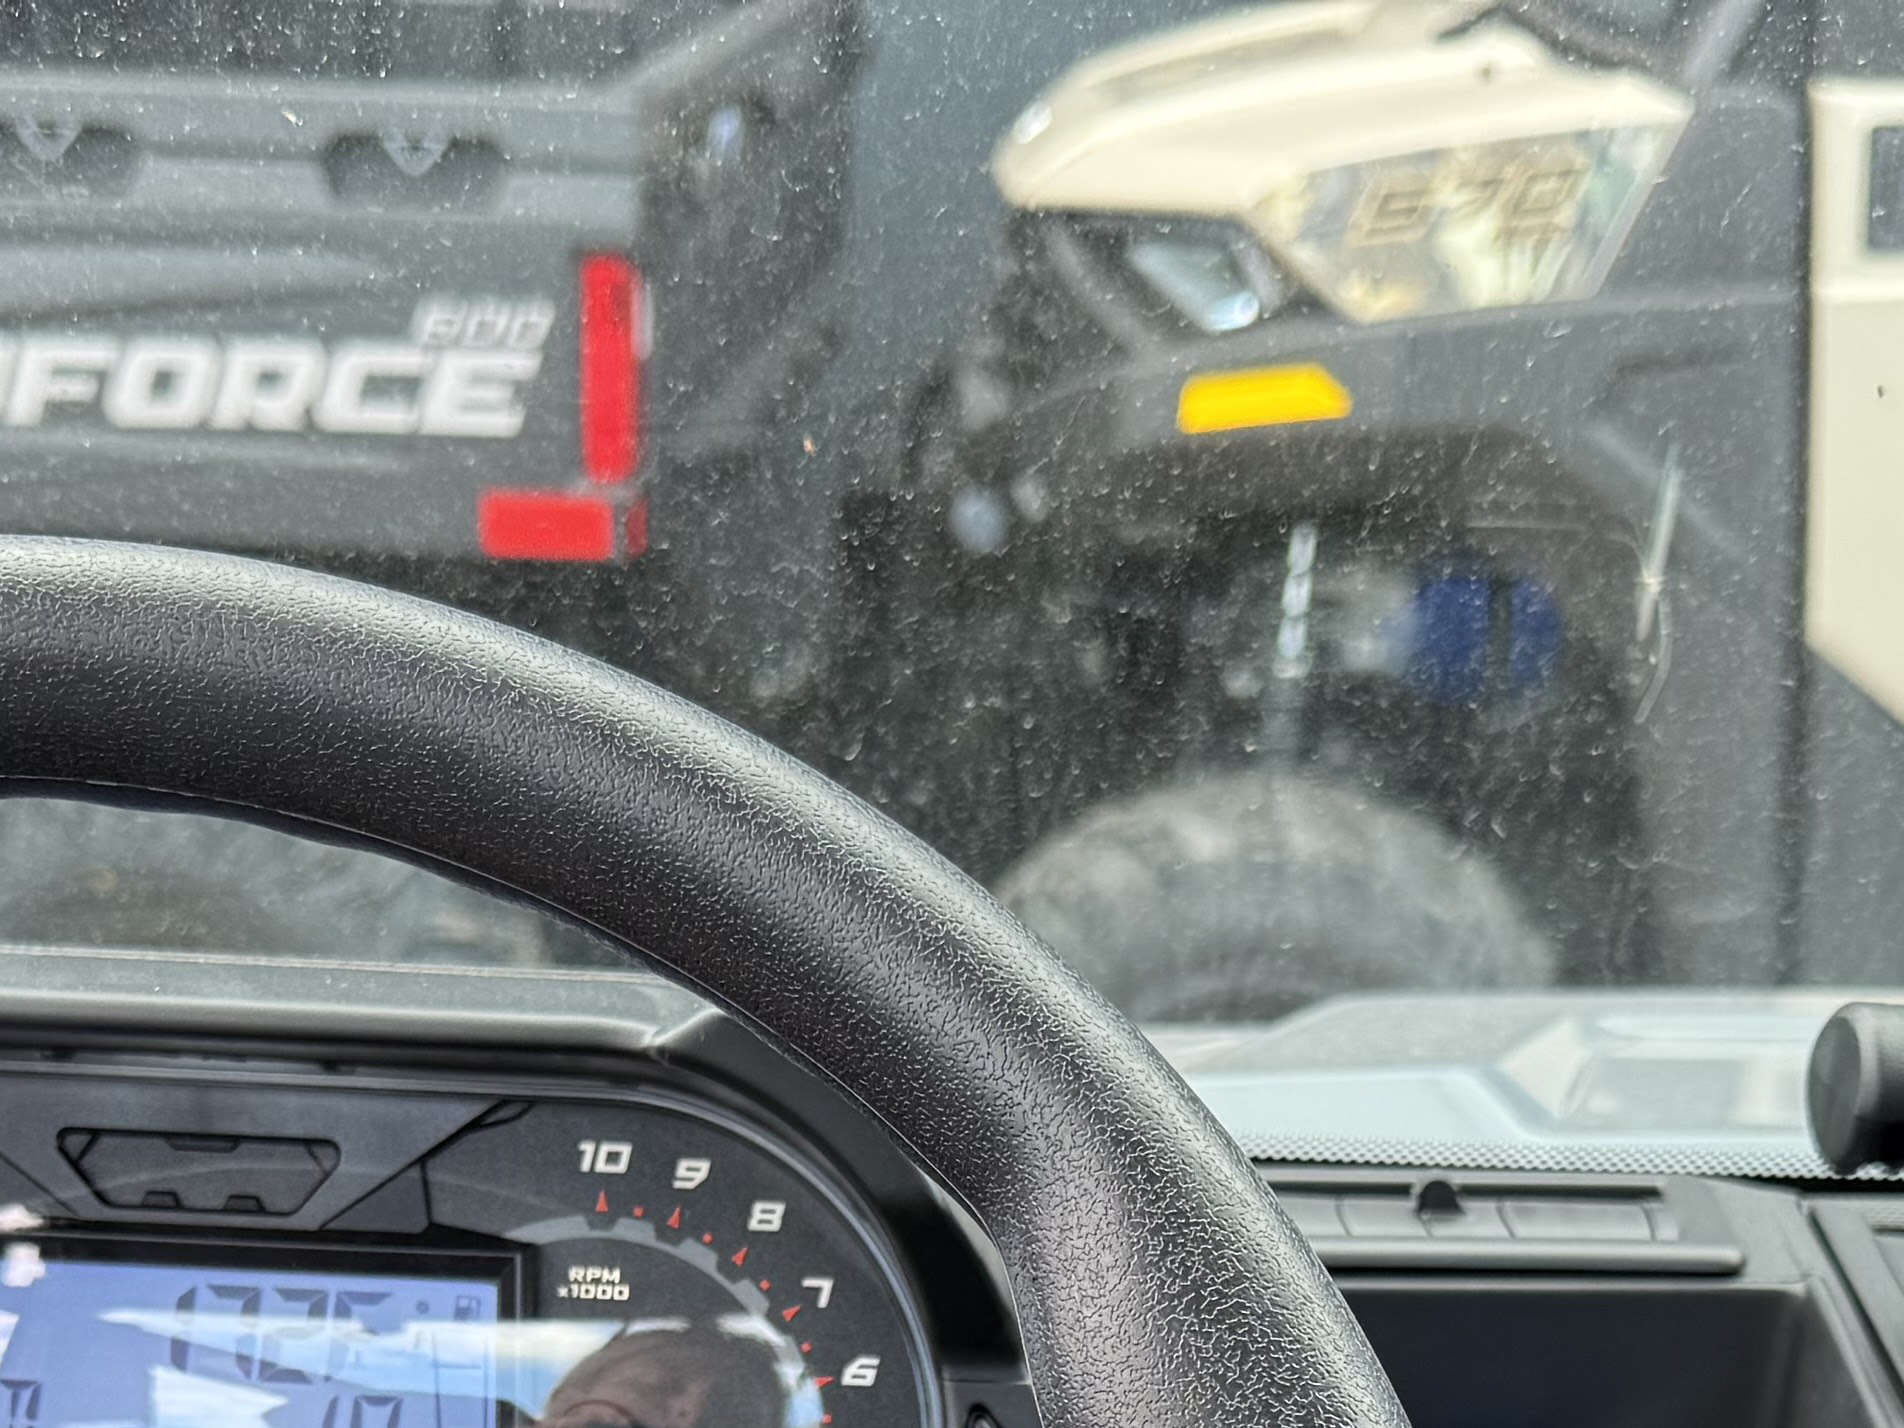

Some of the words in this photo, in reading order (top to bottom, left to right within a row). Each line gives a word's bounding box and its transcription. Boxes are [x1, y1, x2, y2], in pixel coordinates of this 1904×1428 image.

[577, 1140, 633, 1174] 10
[672, 1157, 711, 1189] 9
[747, 1199, 786, 1232] 8
[568, 1265, 621, 1284] RPM
[801, 1275, 834, 1309] 7
[841, 1357, 880, 1386] 6
